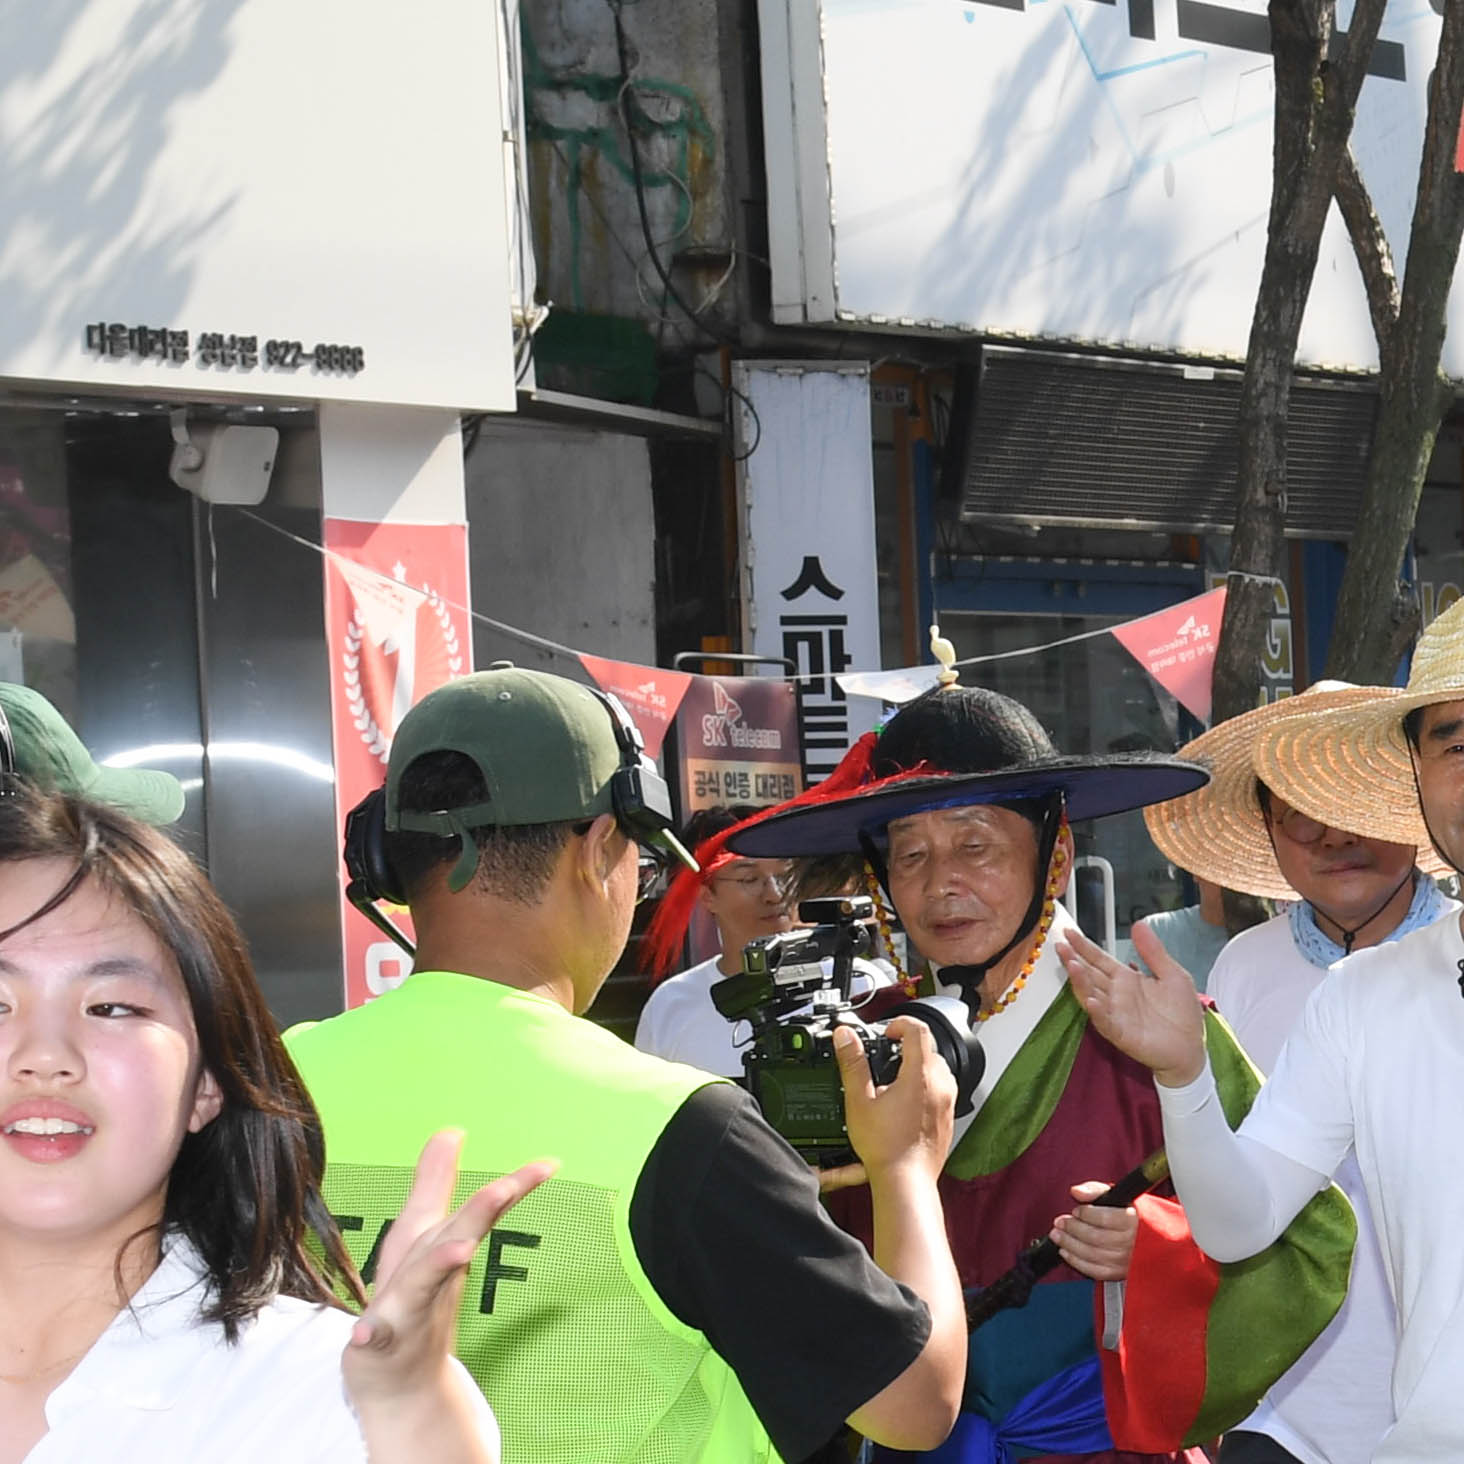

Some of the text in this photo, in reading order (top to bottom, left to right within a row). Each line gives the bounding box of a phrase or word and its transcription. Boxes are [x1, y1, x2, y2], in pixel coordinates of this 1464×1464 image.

[702, 713, 781, 750] SK telecom
[693, 771, 796, 800] 공식 인증 대리점
